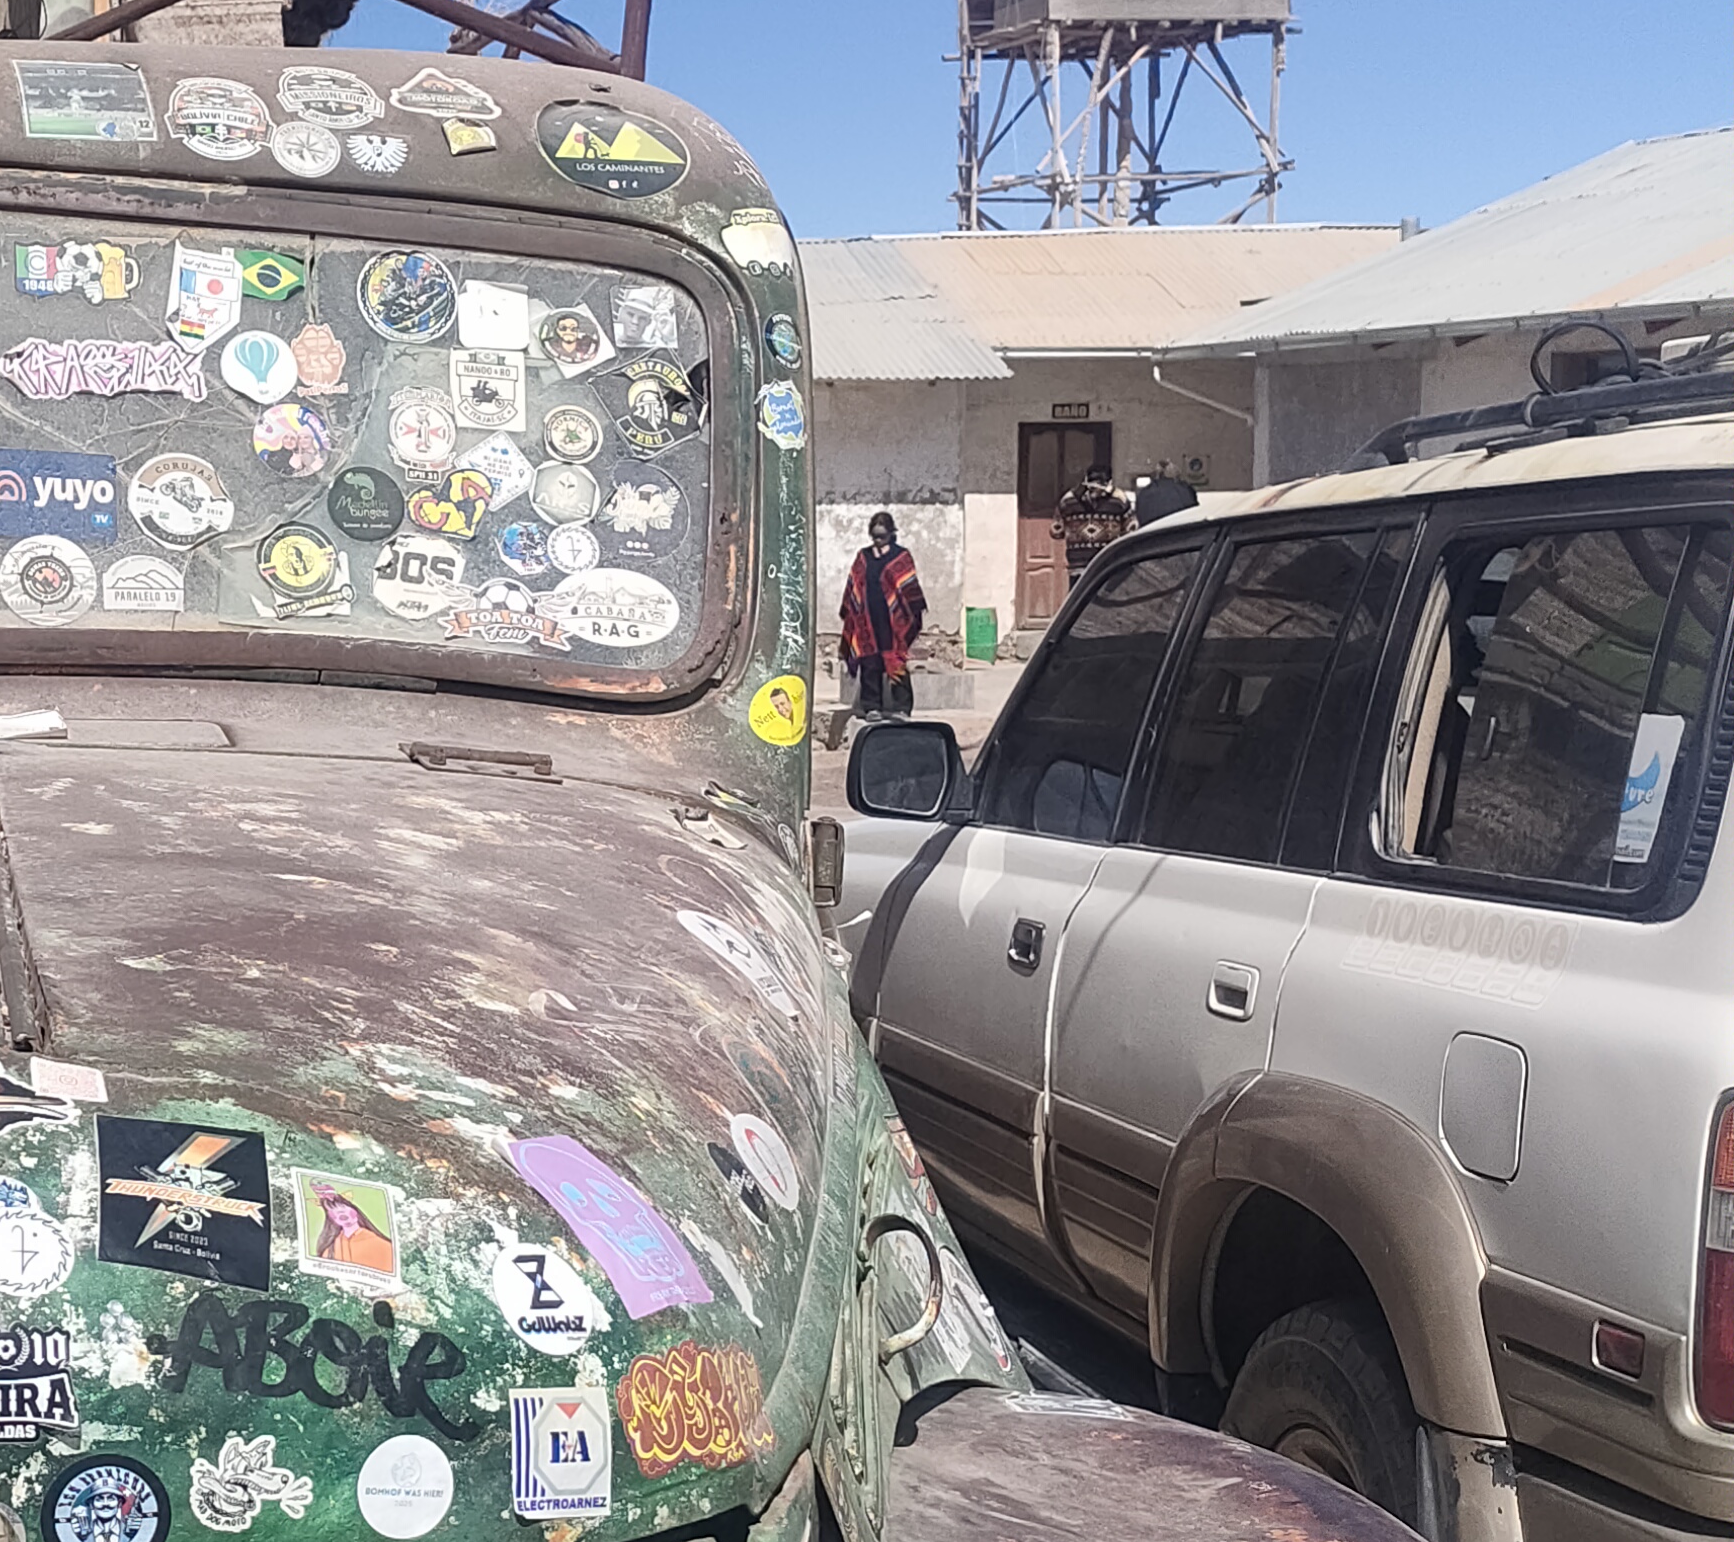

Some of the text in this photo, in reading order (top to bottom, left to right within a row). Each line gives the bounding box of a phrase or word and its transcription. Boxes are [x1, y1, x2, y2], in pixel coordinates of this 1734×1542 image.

[289, 91, 373, 106] MISSIONEIROS
[138, 120, 151, 129] 12
[227, 114, 258, 126] CHILE
[575, 162, 665, 174] LOS CAMINANTES
[463, 365, 511, 377] NANDO RO
[626, 427, 663, 444] PERU
[33, 476, 114, 510] yuyo
[94, 513, 110, 524] TV
[350, 507, 389, 519] bungee
[114, 590, 177, 603] PARALELO 19
[584, 606, 646, 621] CABAÑA
[466, 611, 544, 632] TOA TOA
[754, 711, 777, 729] Nett
[105, 1178, 266, 1226] THUNDERSTRUCK
[168, 1231, 188, 1243] SINCE
[153, 1240, 220, 1260] Santa Cruz Bolivia
[33, 1332, 67, 1367] 10
[549, 1430, 592, 1464] EA
[365, 1487, 403, 1497] BOMHOF
[404, 1488, 422, 1497] WAS
[517, 1496, 608, 1512] ELECTROARNEZ
[195, 1499, 248, 1527] MAD DOG MOTO
